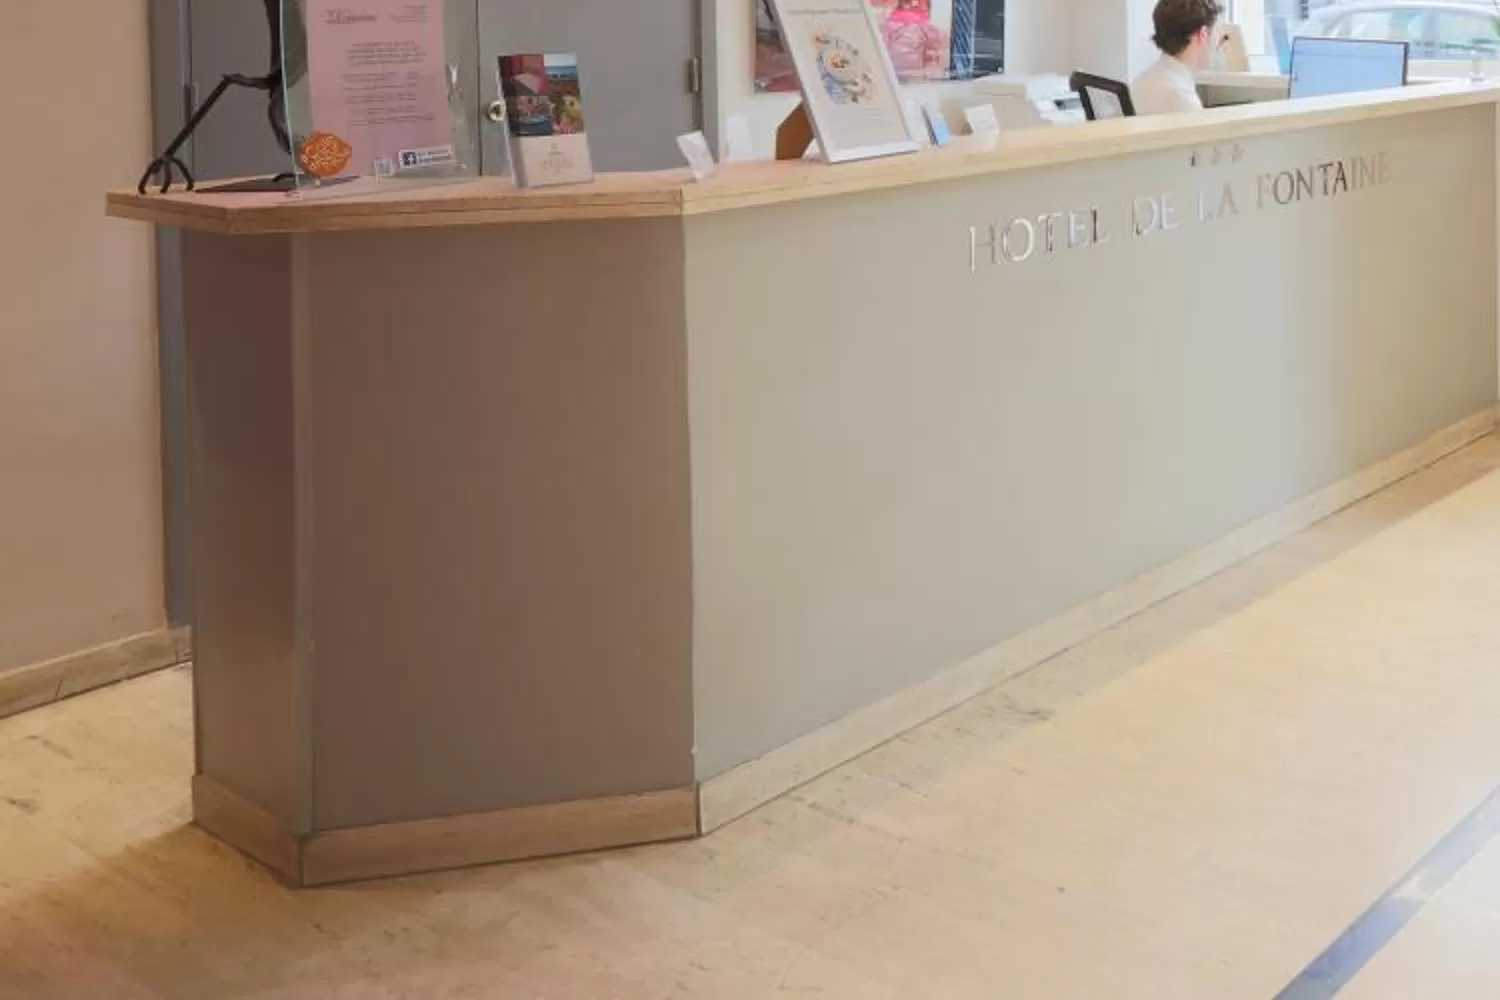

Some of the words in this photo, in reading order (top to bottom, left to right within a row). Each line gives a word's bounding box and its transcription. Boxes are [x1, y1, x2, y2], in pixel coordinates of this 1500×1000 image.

[969, 205, 1109, 272] HOTEL
[1131, 192, 1183, 238] DE
[1198, 179, 1240, 225] LA
[1255, 152, 1392, 208] FONTAINE
